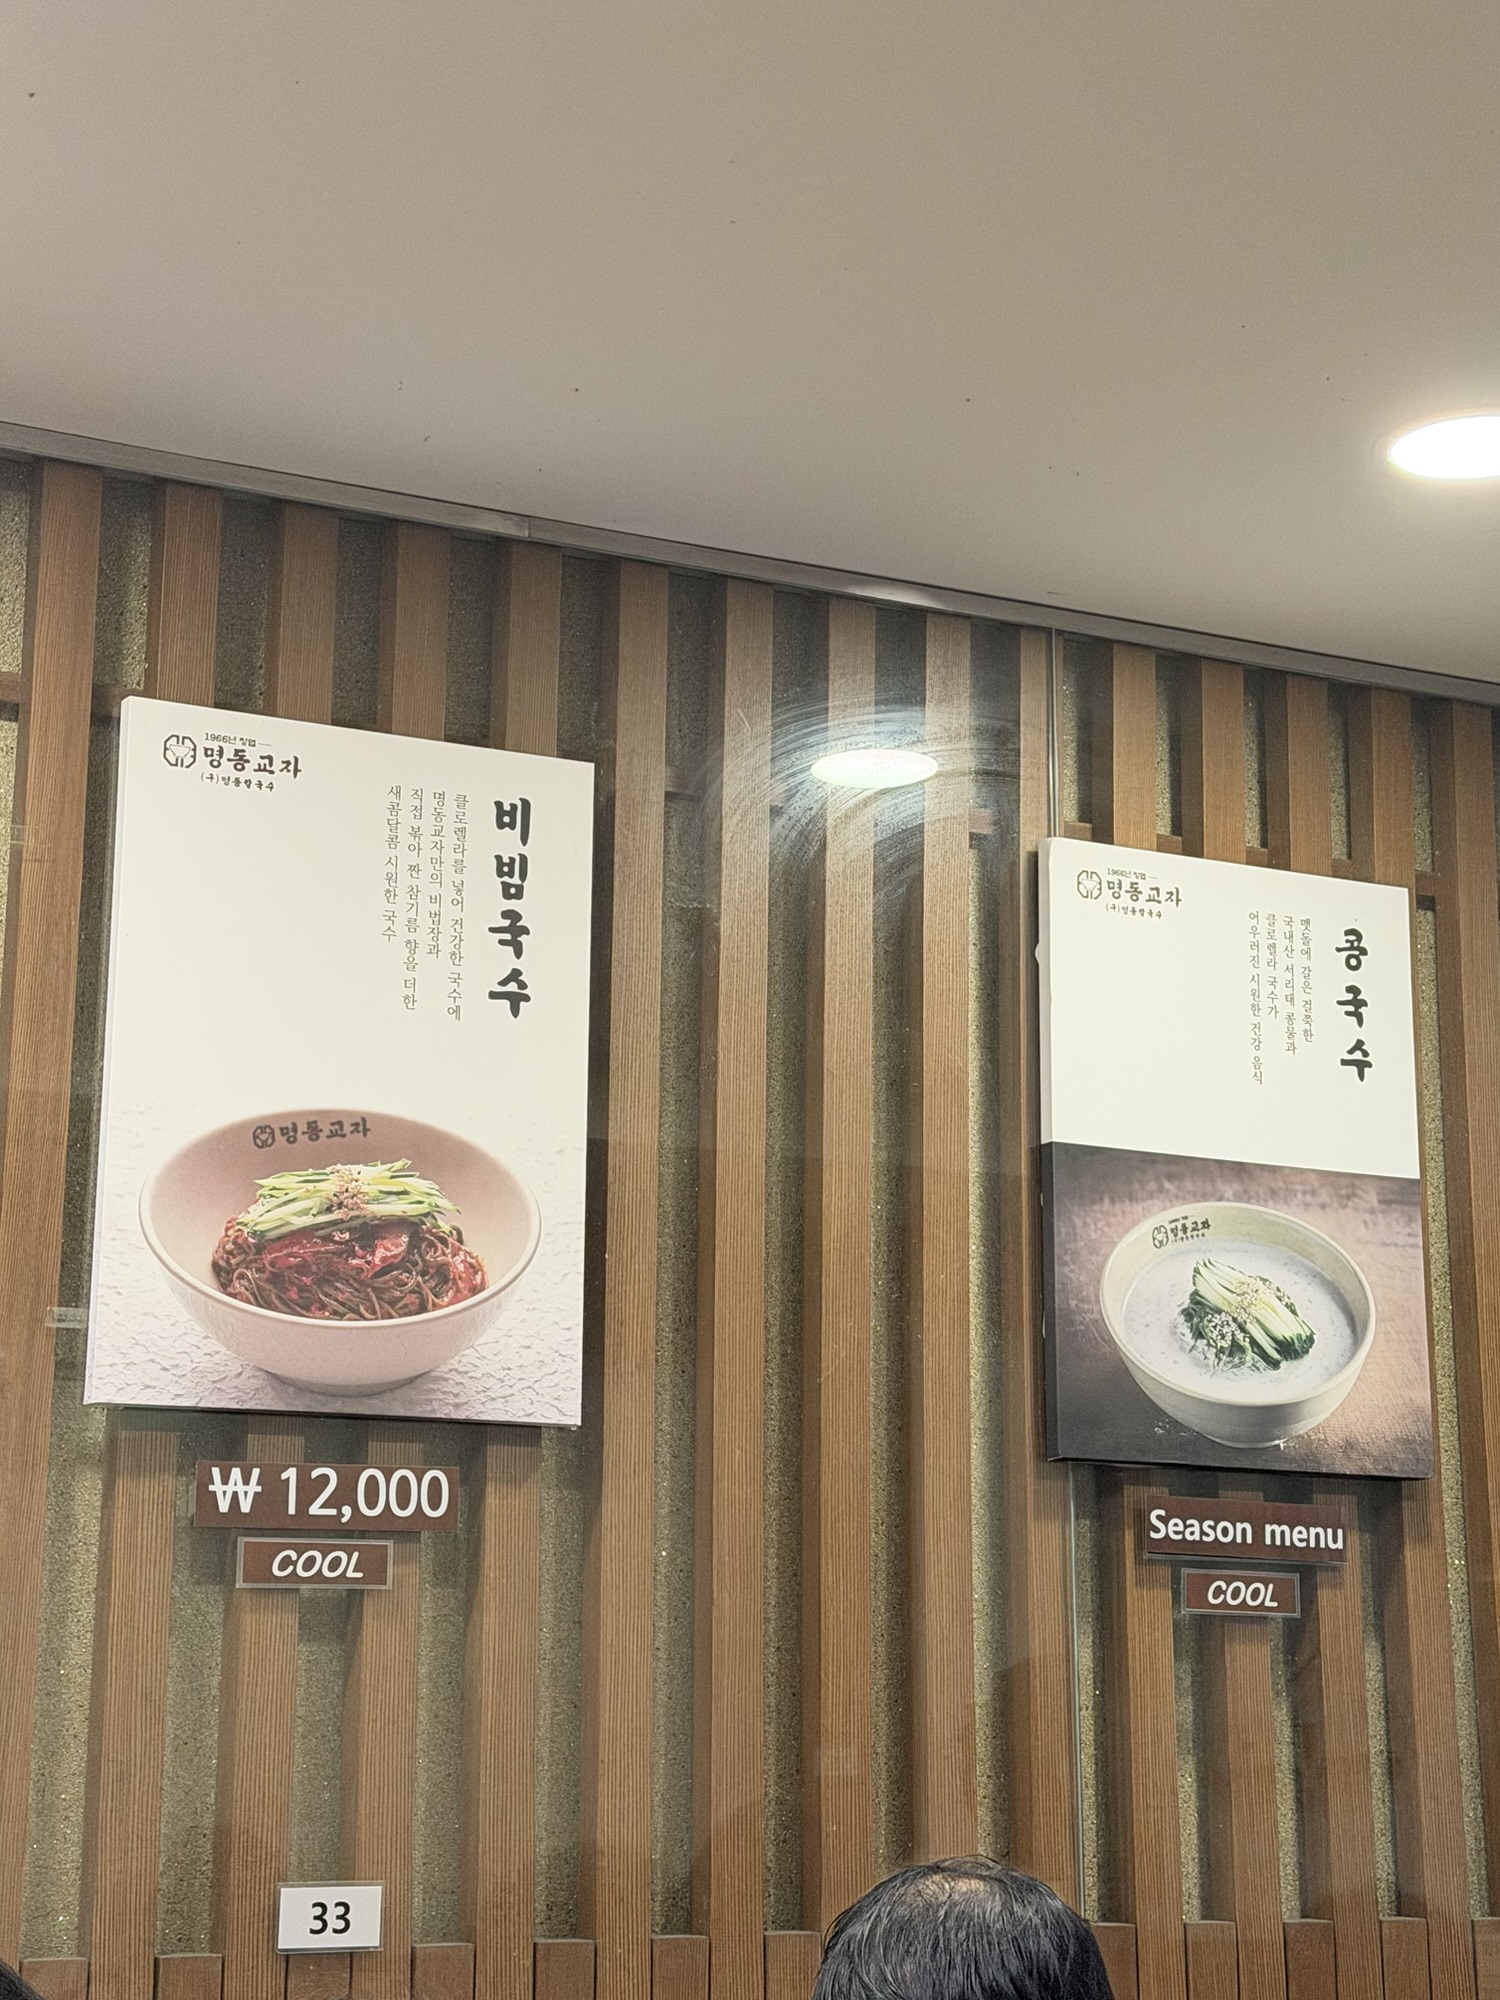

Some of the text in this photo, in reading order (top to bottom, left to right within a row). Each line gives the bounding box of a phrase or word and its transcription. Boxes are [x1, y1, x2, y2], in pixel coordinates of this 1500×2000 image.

[202, 745, 302, 779] 명동교자
[204, 732, 257, 748] 1966년 창업
[381, 784, 403, 943] 새콤달콤 시원한 국수
[401, 787, 424, 1011] 직접 볶아 짠 참기름 향을 더한
[425, 790, 447, 960] 명동교자만의 비법장과
[1106, 867, 1132, 879] 1966년
[1106, 879, 1182, 908] 명동교자
[446, 793, 470, 1022] 클로렐라를 넣어 건강한 국수에
[487, 796, 532, 1020] 비빔국수
[1248, 910, 1264, 1086] 어우러진 시원한 건강 음식
[1265, 912, 1280, 1020] 클로렐라 국수가
[1282, 915, 1298, 1056] 국내산 서리태 콩물과
[1300, 917, 1315, 1043] 맷돌에 갈은 걸쭉한
[1334, 927, 1374, 1083] 콩국수
[278, 1116, 371, 1145] 명동교자
[280, 1466, 449, 1524] 12,000
[1149, 1509, 1344, 1550] Season menu
[271, 1549, 364, 1578] COOL
[1207, 1580, 1279, 1607] COOL
[308, 1901, 351, 1935] 33
